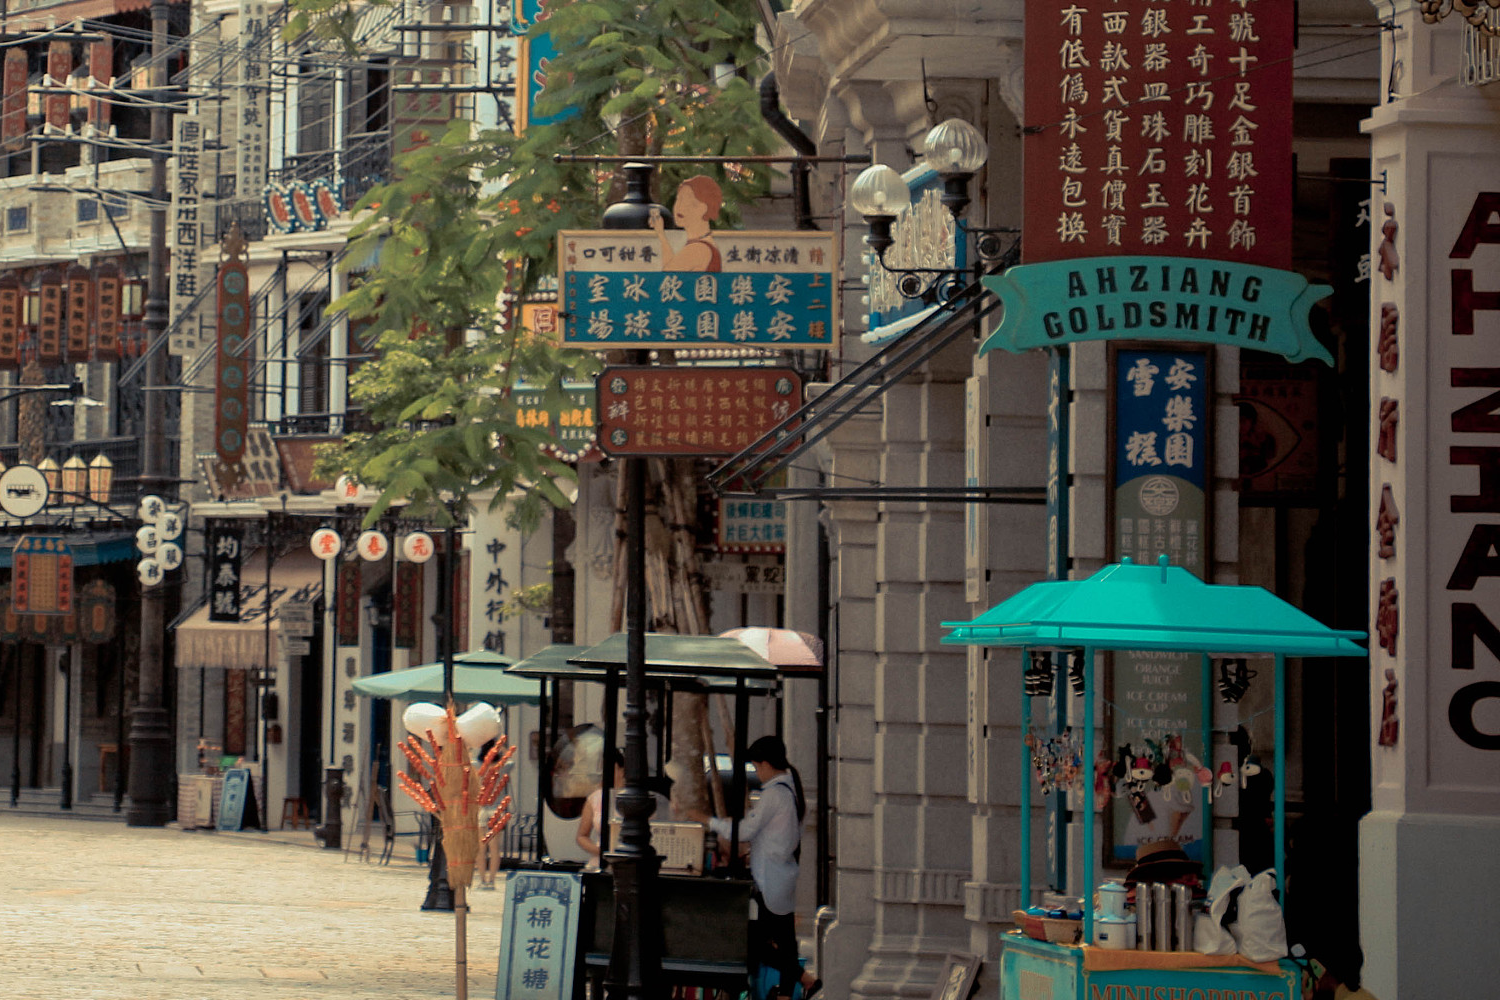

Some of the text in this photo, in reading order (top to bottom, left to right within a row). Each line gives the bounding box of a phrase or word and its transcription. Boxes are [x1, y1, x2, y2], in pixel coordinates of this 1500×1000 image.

[1067, 264, 1264, 303] AHZIANG
[1042, 301, 1272, 344] GOLDSMITH
[1161, 358, 1196, 469] 安樂園
[1135, 663, 1182, 675] ORANGE
[1142, 674, 1174, 685] JUICE
[1126, 690, 1188, 702] ICE CREAM
[1145, 701, 1168, 713] CUP
[522, 906, 555, 990] 棉花糖
